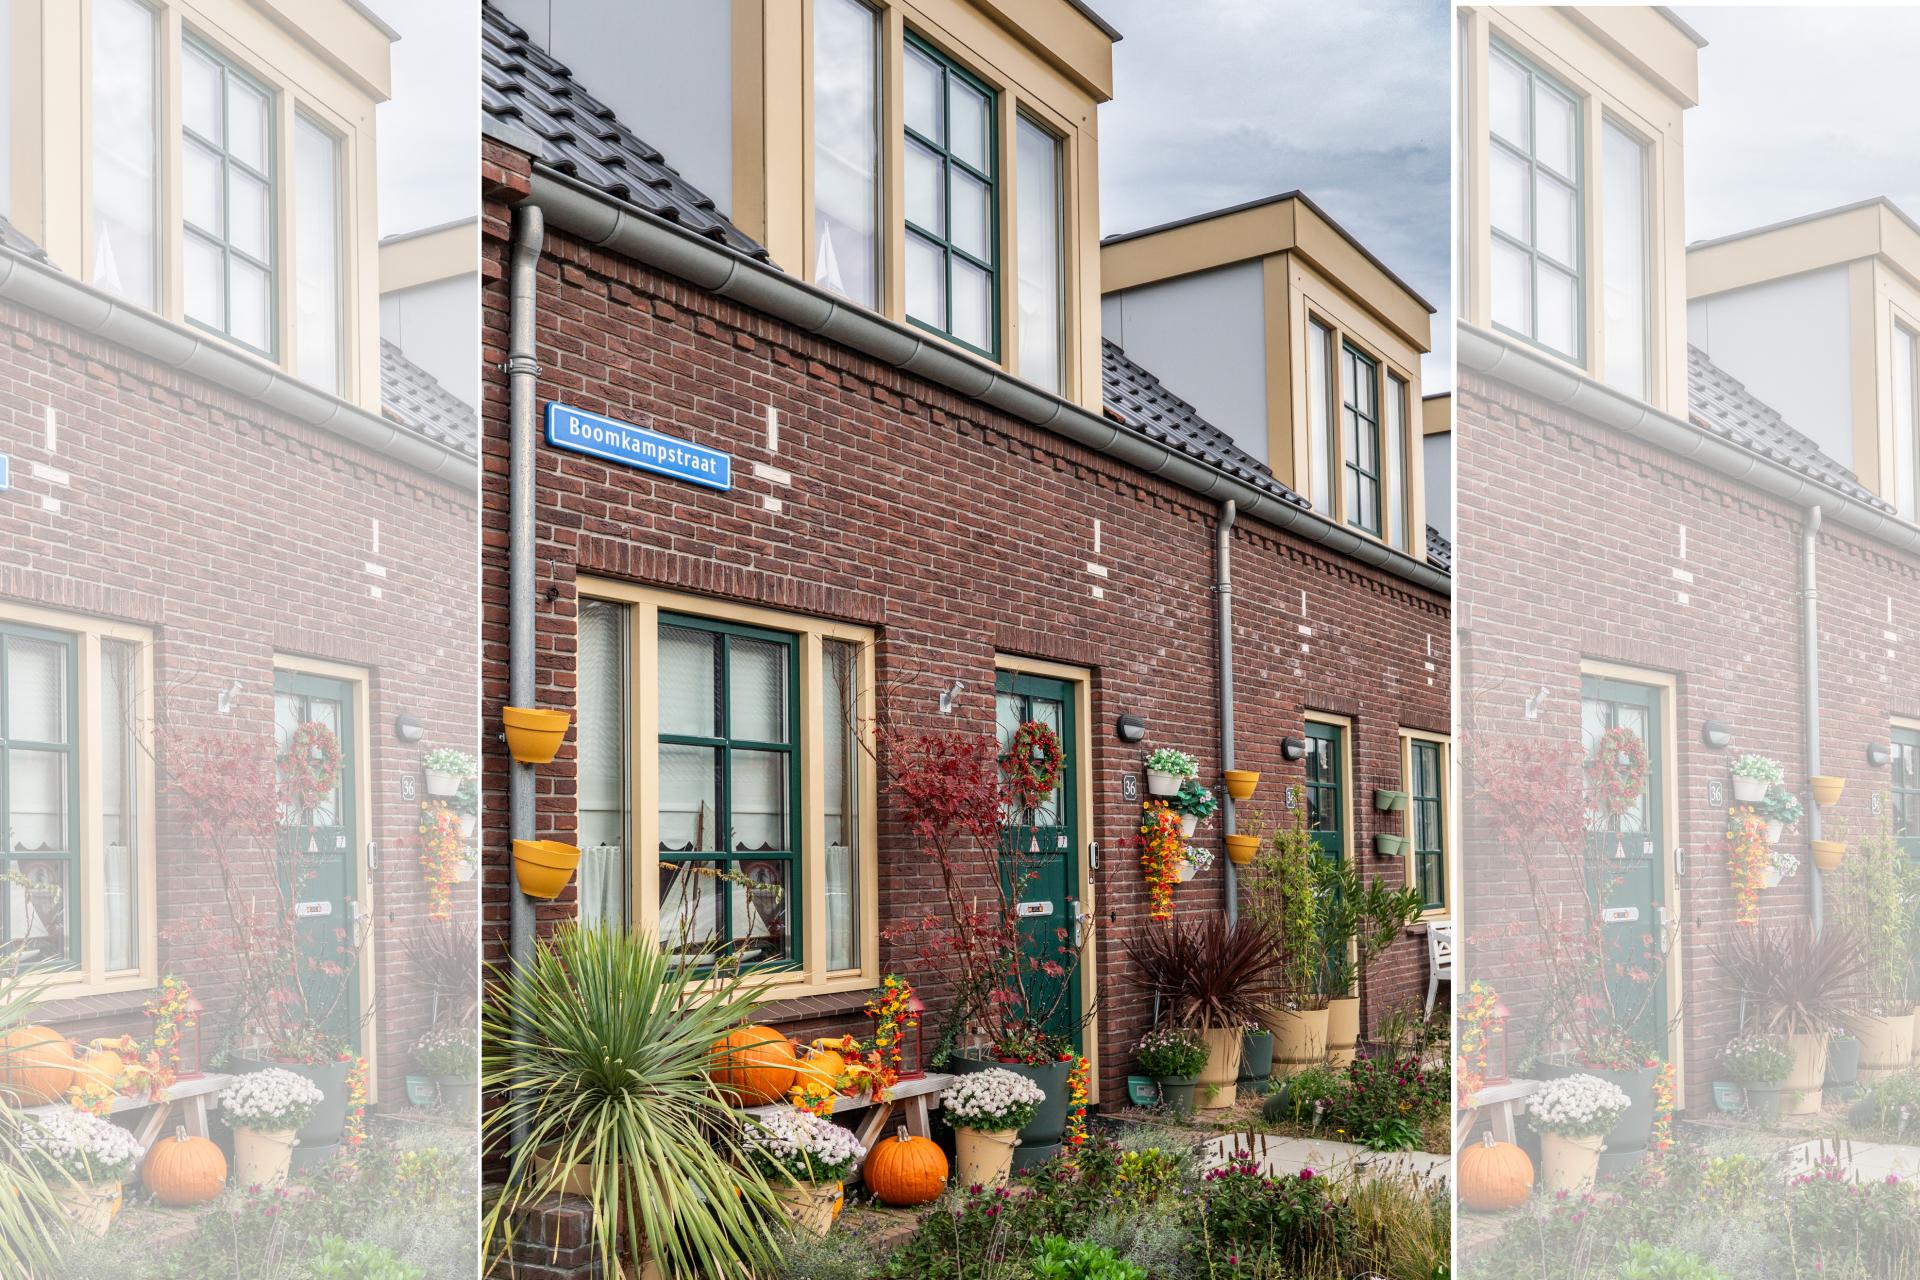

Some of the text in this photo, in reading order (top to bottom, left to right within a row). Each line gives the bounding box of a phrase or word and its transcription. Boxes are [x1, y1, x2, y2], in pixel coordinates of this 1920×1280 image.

[569, 416, 717, 475] Boomkampstraat
[403, 780, 414, 796] 36
[1125, 780, 1136, 796] 36
[1711, 785, 1721, 801] 36
